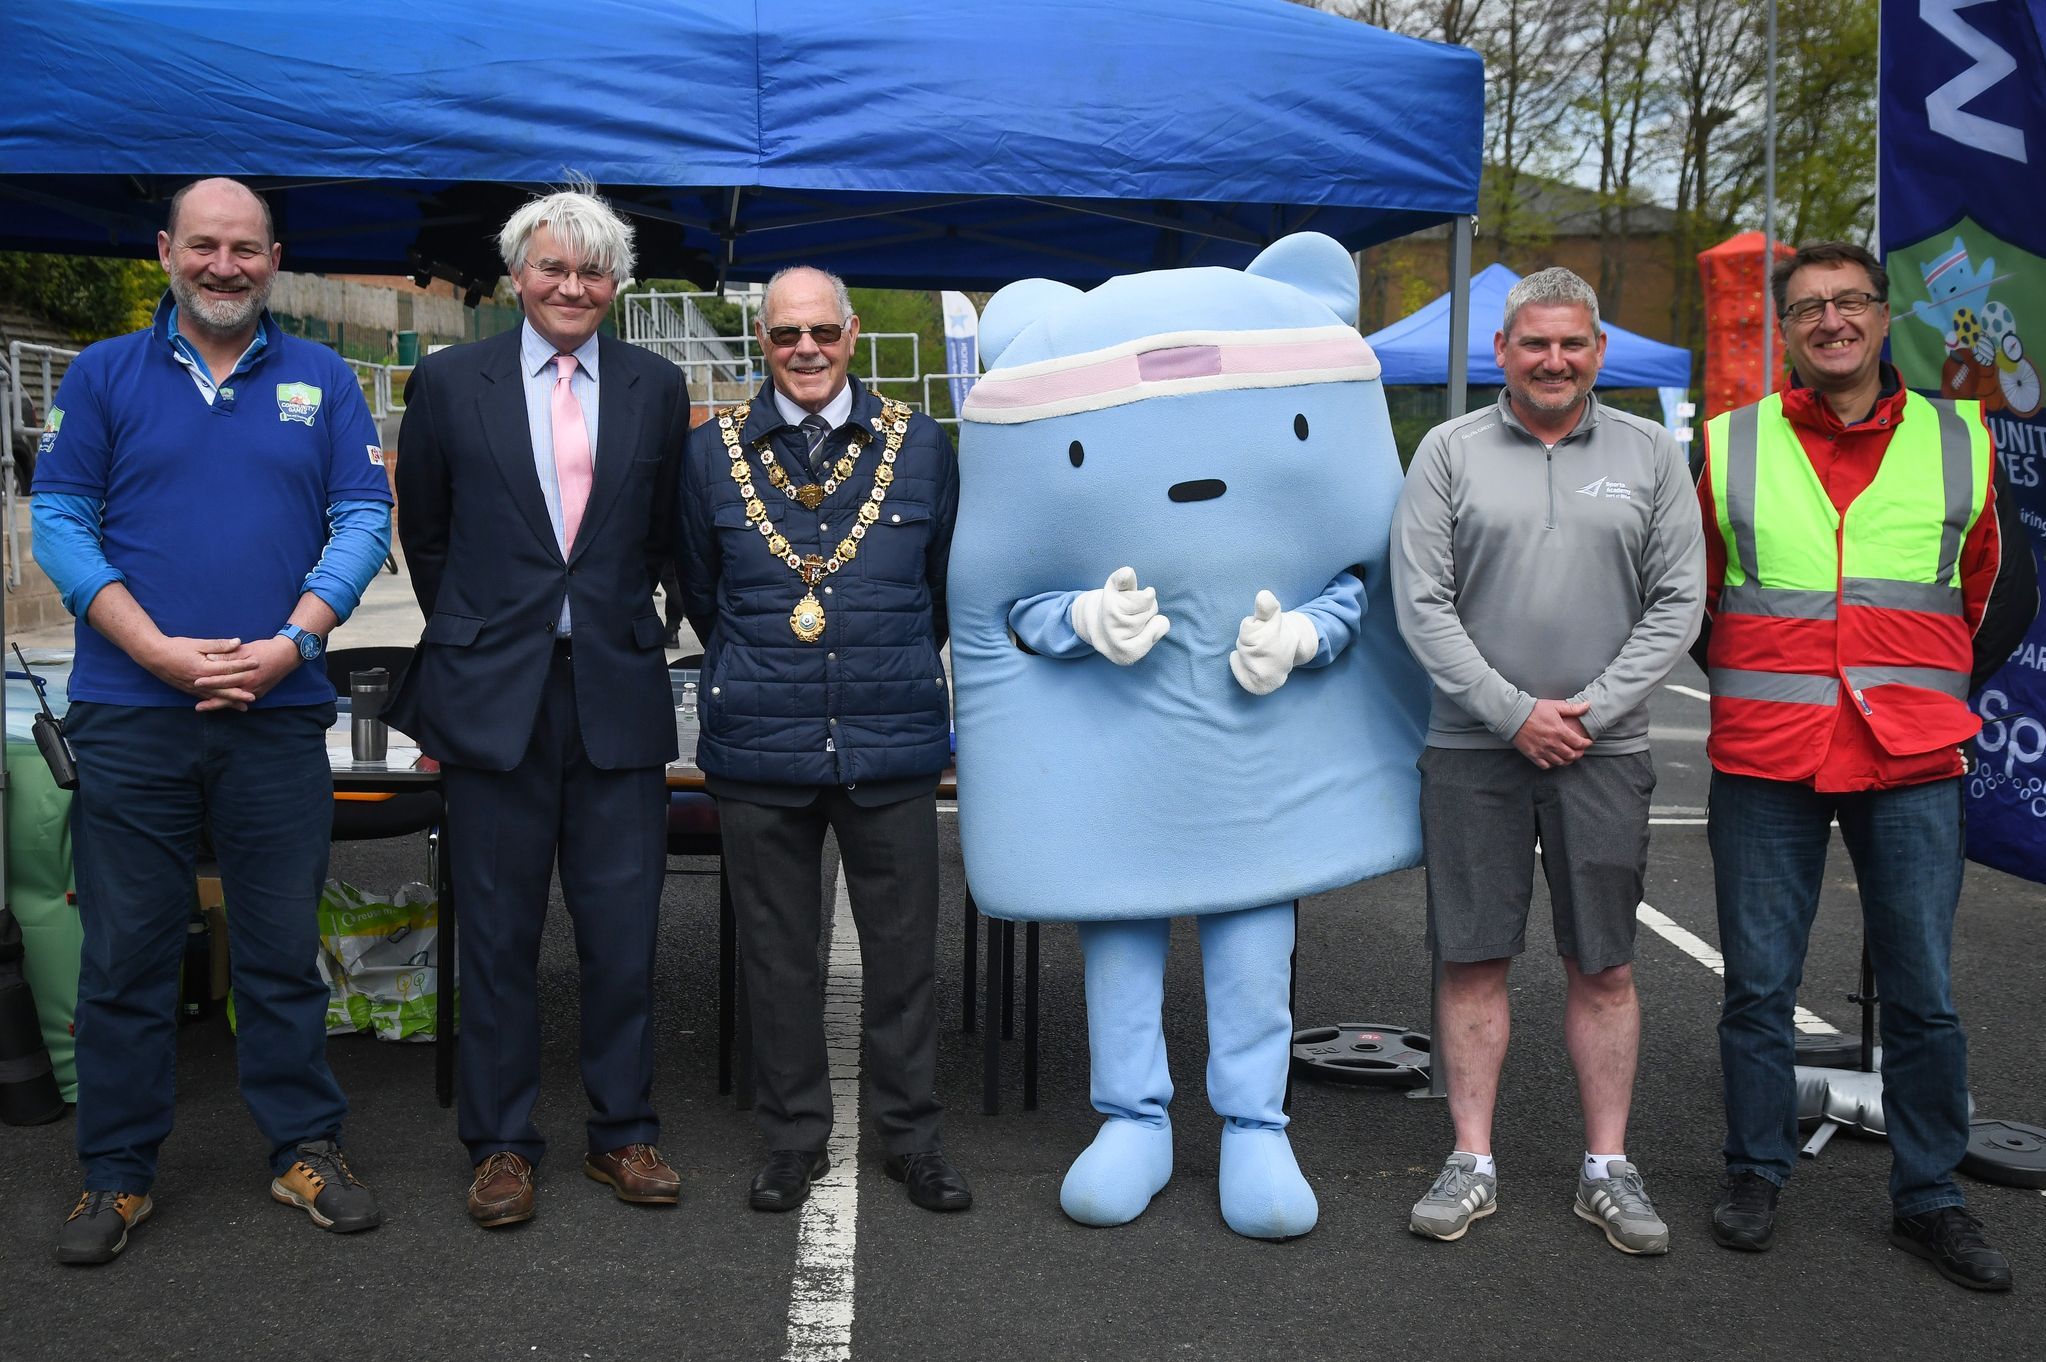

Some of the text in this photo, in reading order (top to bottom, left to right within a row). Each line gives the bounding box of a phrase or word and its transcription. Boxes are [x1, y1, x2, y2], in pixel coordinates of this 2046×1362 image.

[281, 402, 315, 411] COMMUNITY
[1986, 417, 2046, 458] UNIT
[1997, 451, 2040, 487] ES
